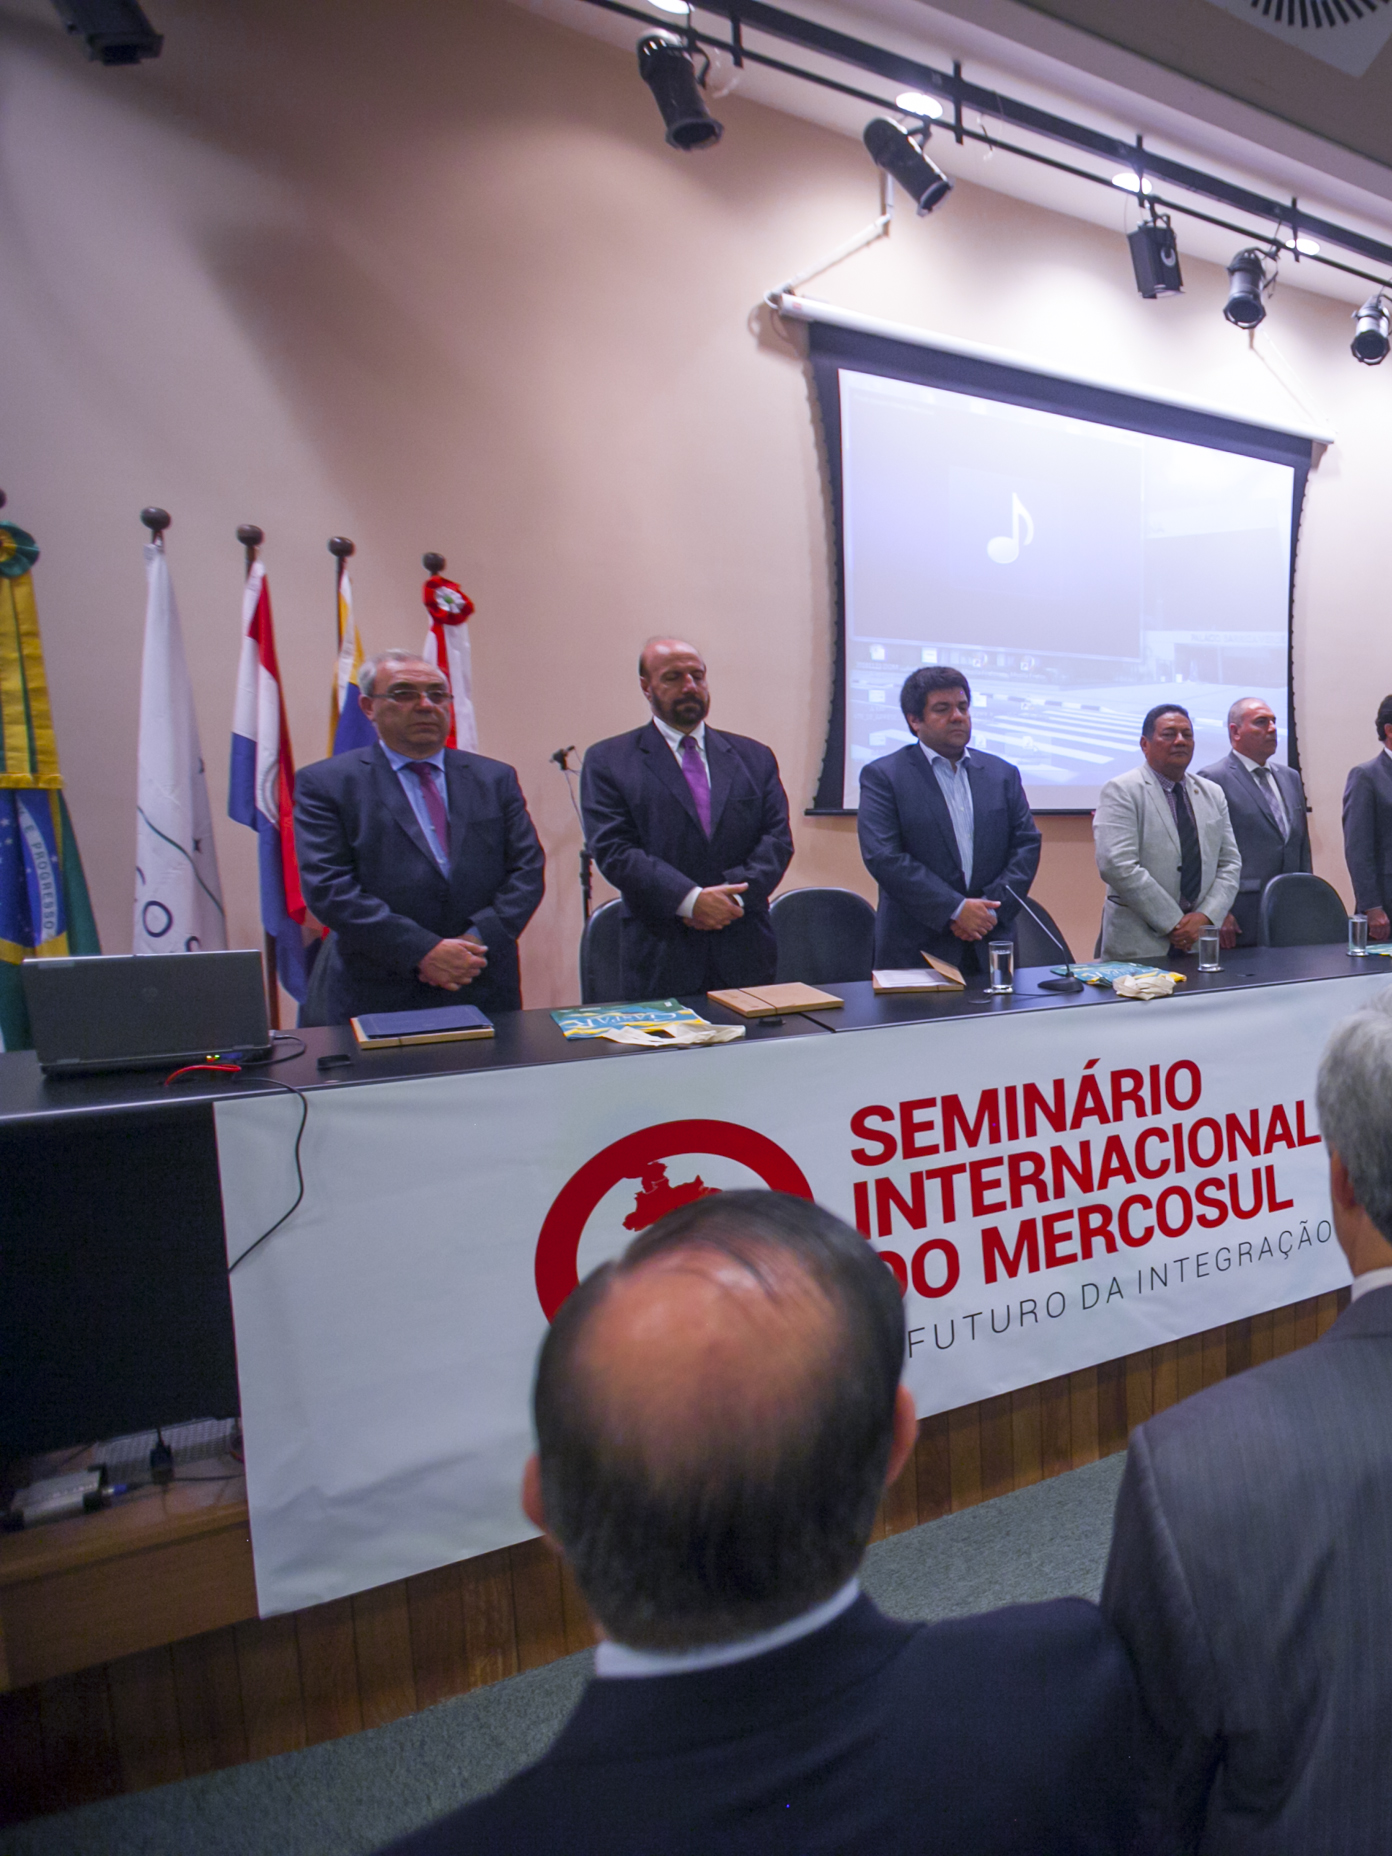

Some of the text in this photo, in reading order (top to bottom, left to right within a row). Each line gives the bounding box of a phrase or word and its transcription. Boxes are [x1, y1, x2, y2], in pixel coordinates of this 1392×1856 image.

[31, 842, 55, 931] PROGRESSO
[850, 1058, 1202, 1167] SEMINÁRIO
[853, 1100, 1323, 1240] INTERNACIONAL
[981, 1164, 1294, 1285] MERCOSUL
[907, 1219, 1332, 1359] FUTURO DA INTEGRAÇÃO
